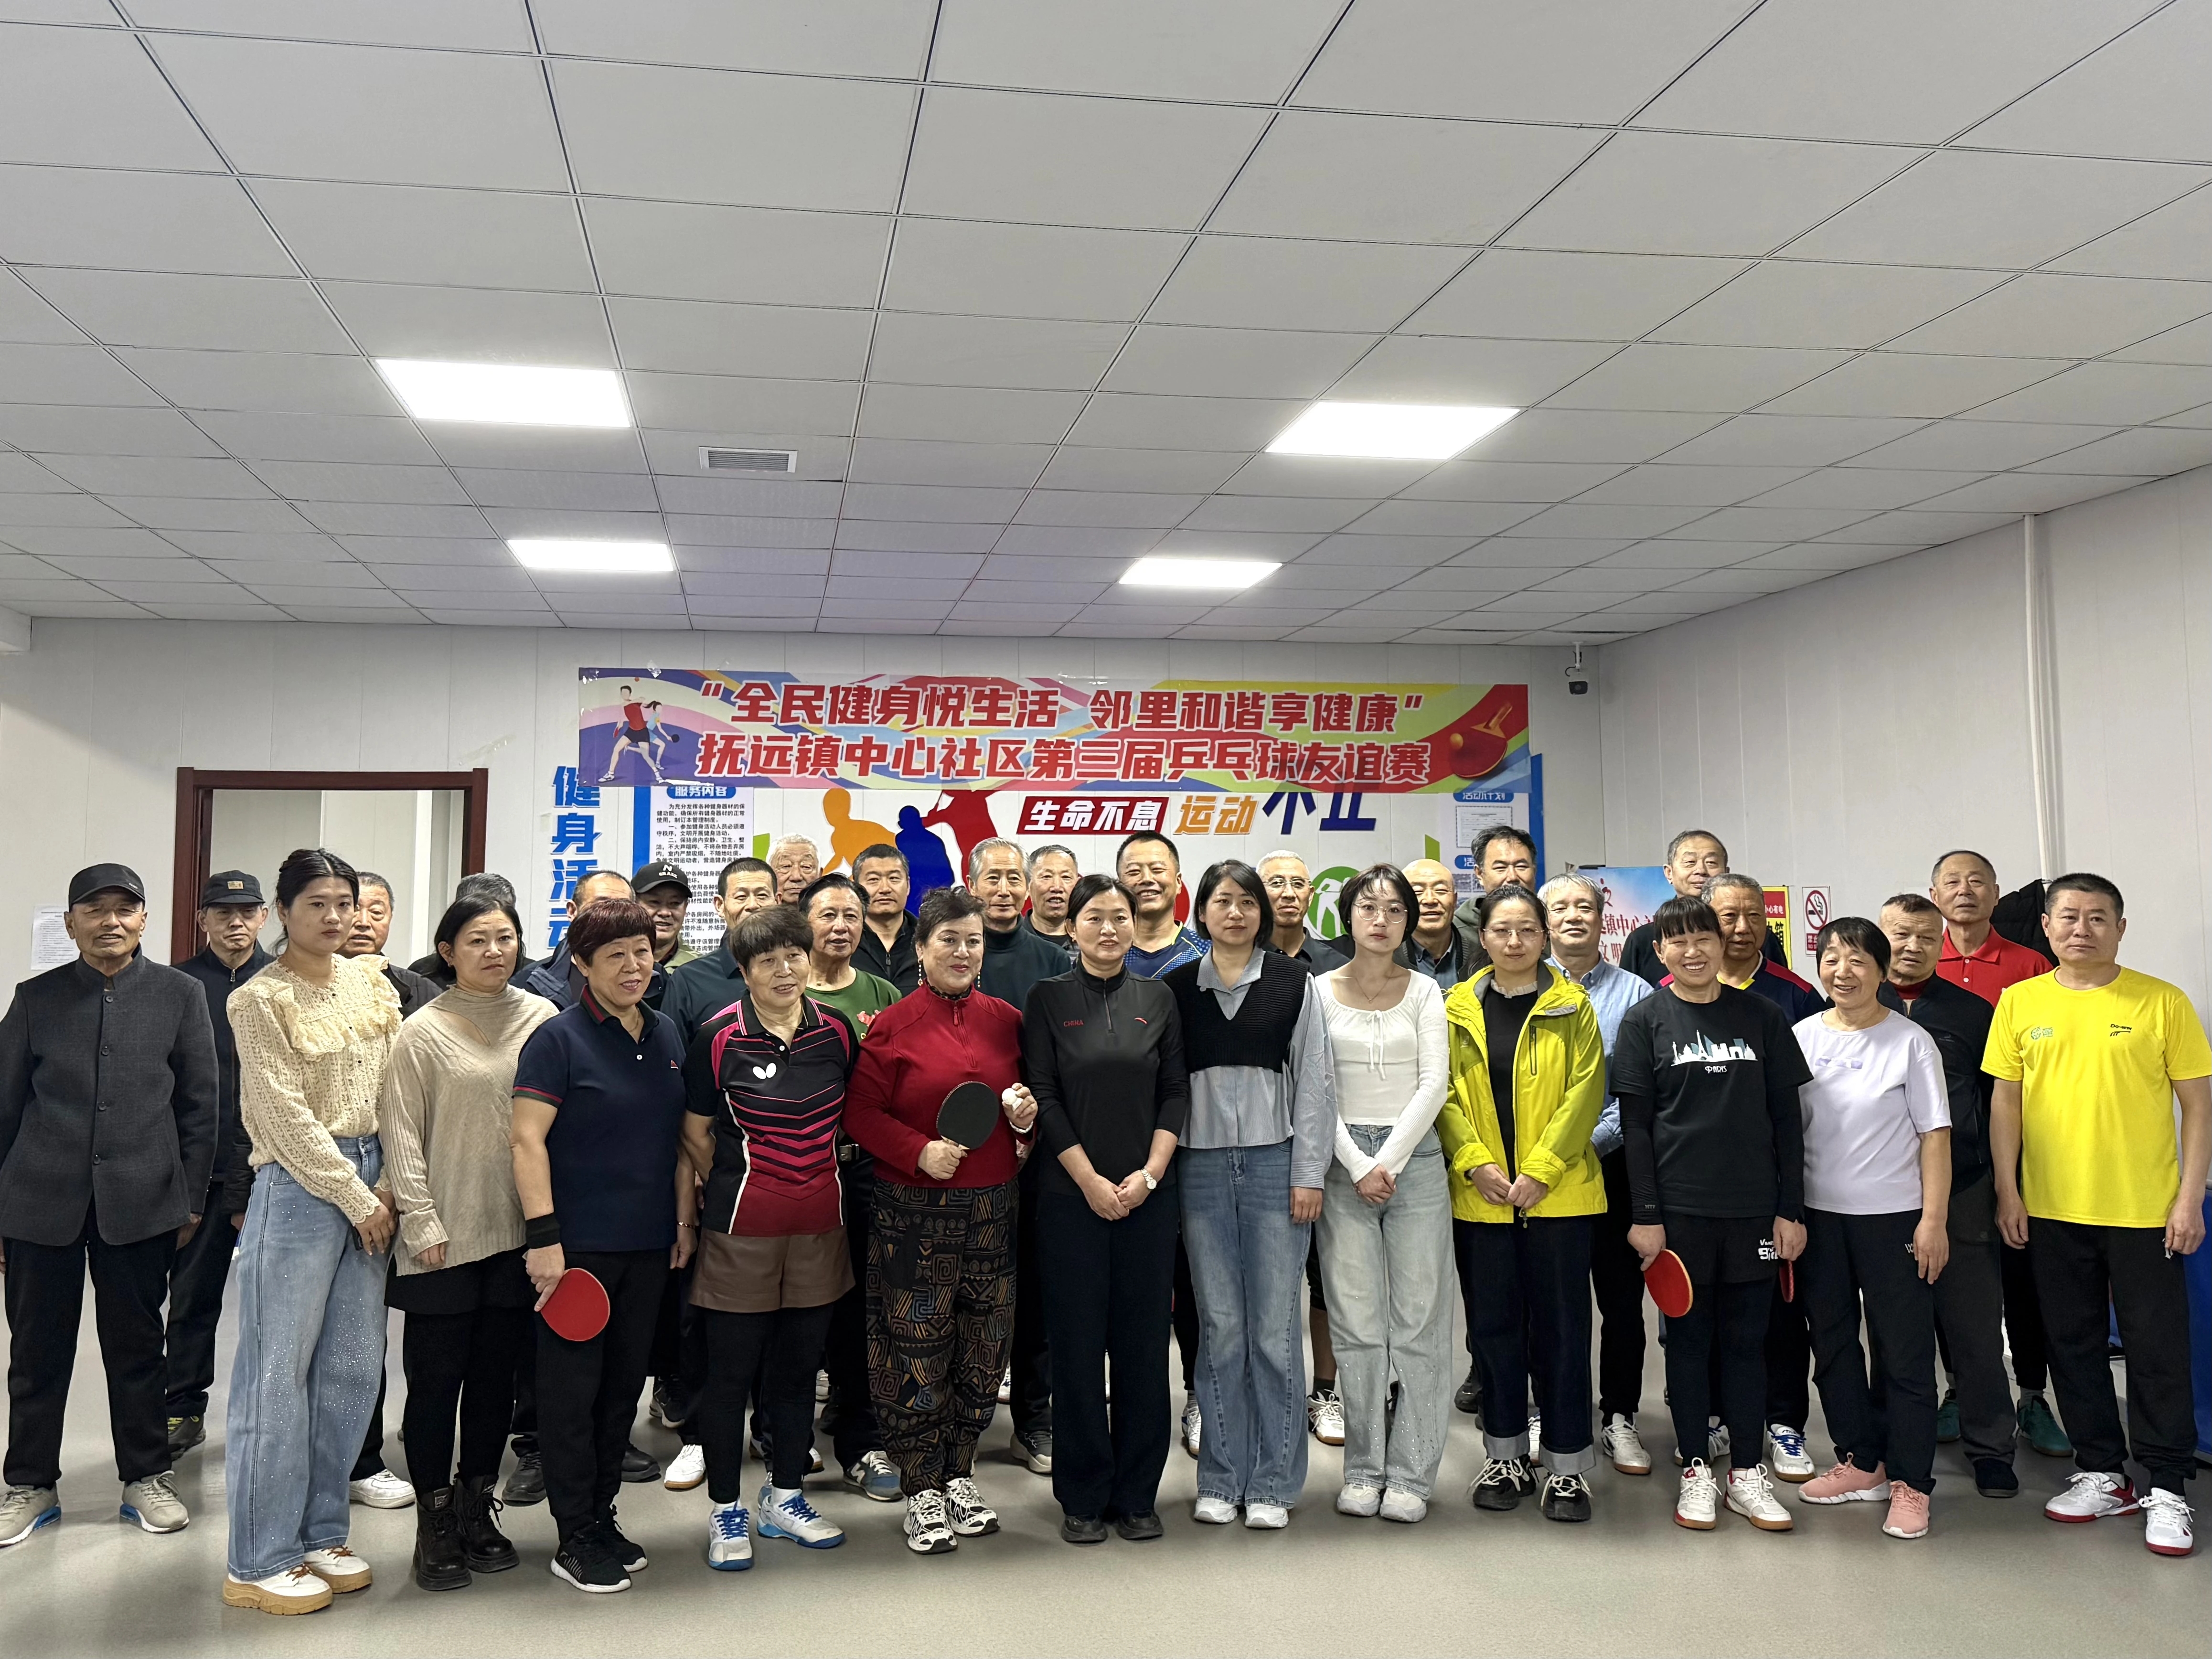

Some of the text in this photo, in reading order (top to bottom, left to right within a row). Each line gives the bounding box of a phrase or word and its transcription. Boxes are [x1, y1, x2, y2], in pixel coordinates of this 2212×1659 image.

[696, 733, 1430, 783] 抚远镇中心社区第三届乒乓球友谊赛
[674, 786, 727, 797] 服务内容
[1024, 800, 1162, 831] 生命不息
[1173, 795, 1260, 835] 运动
